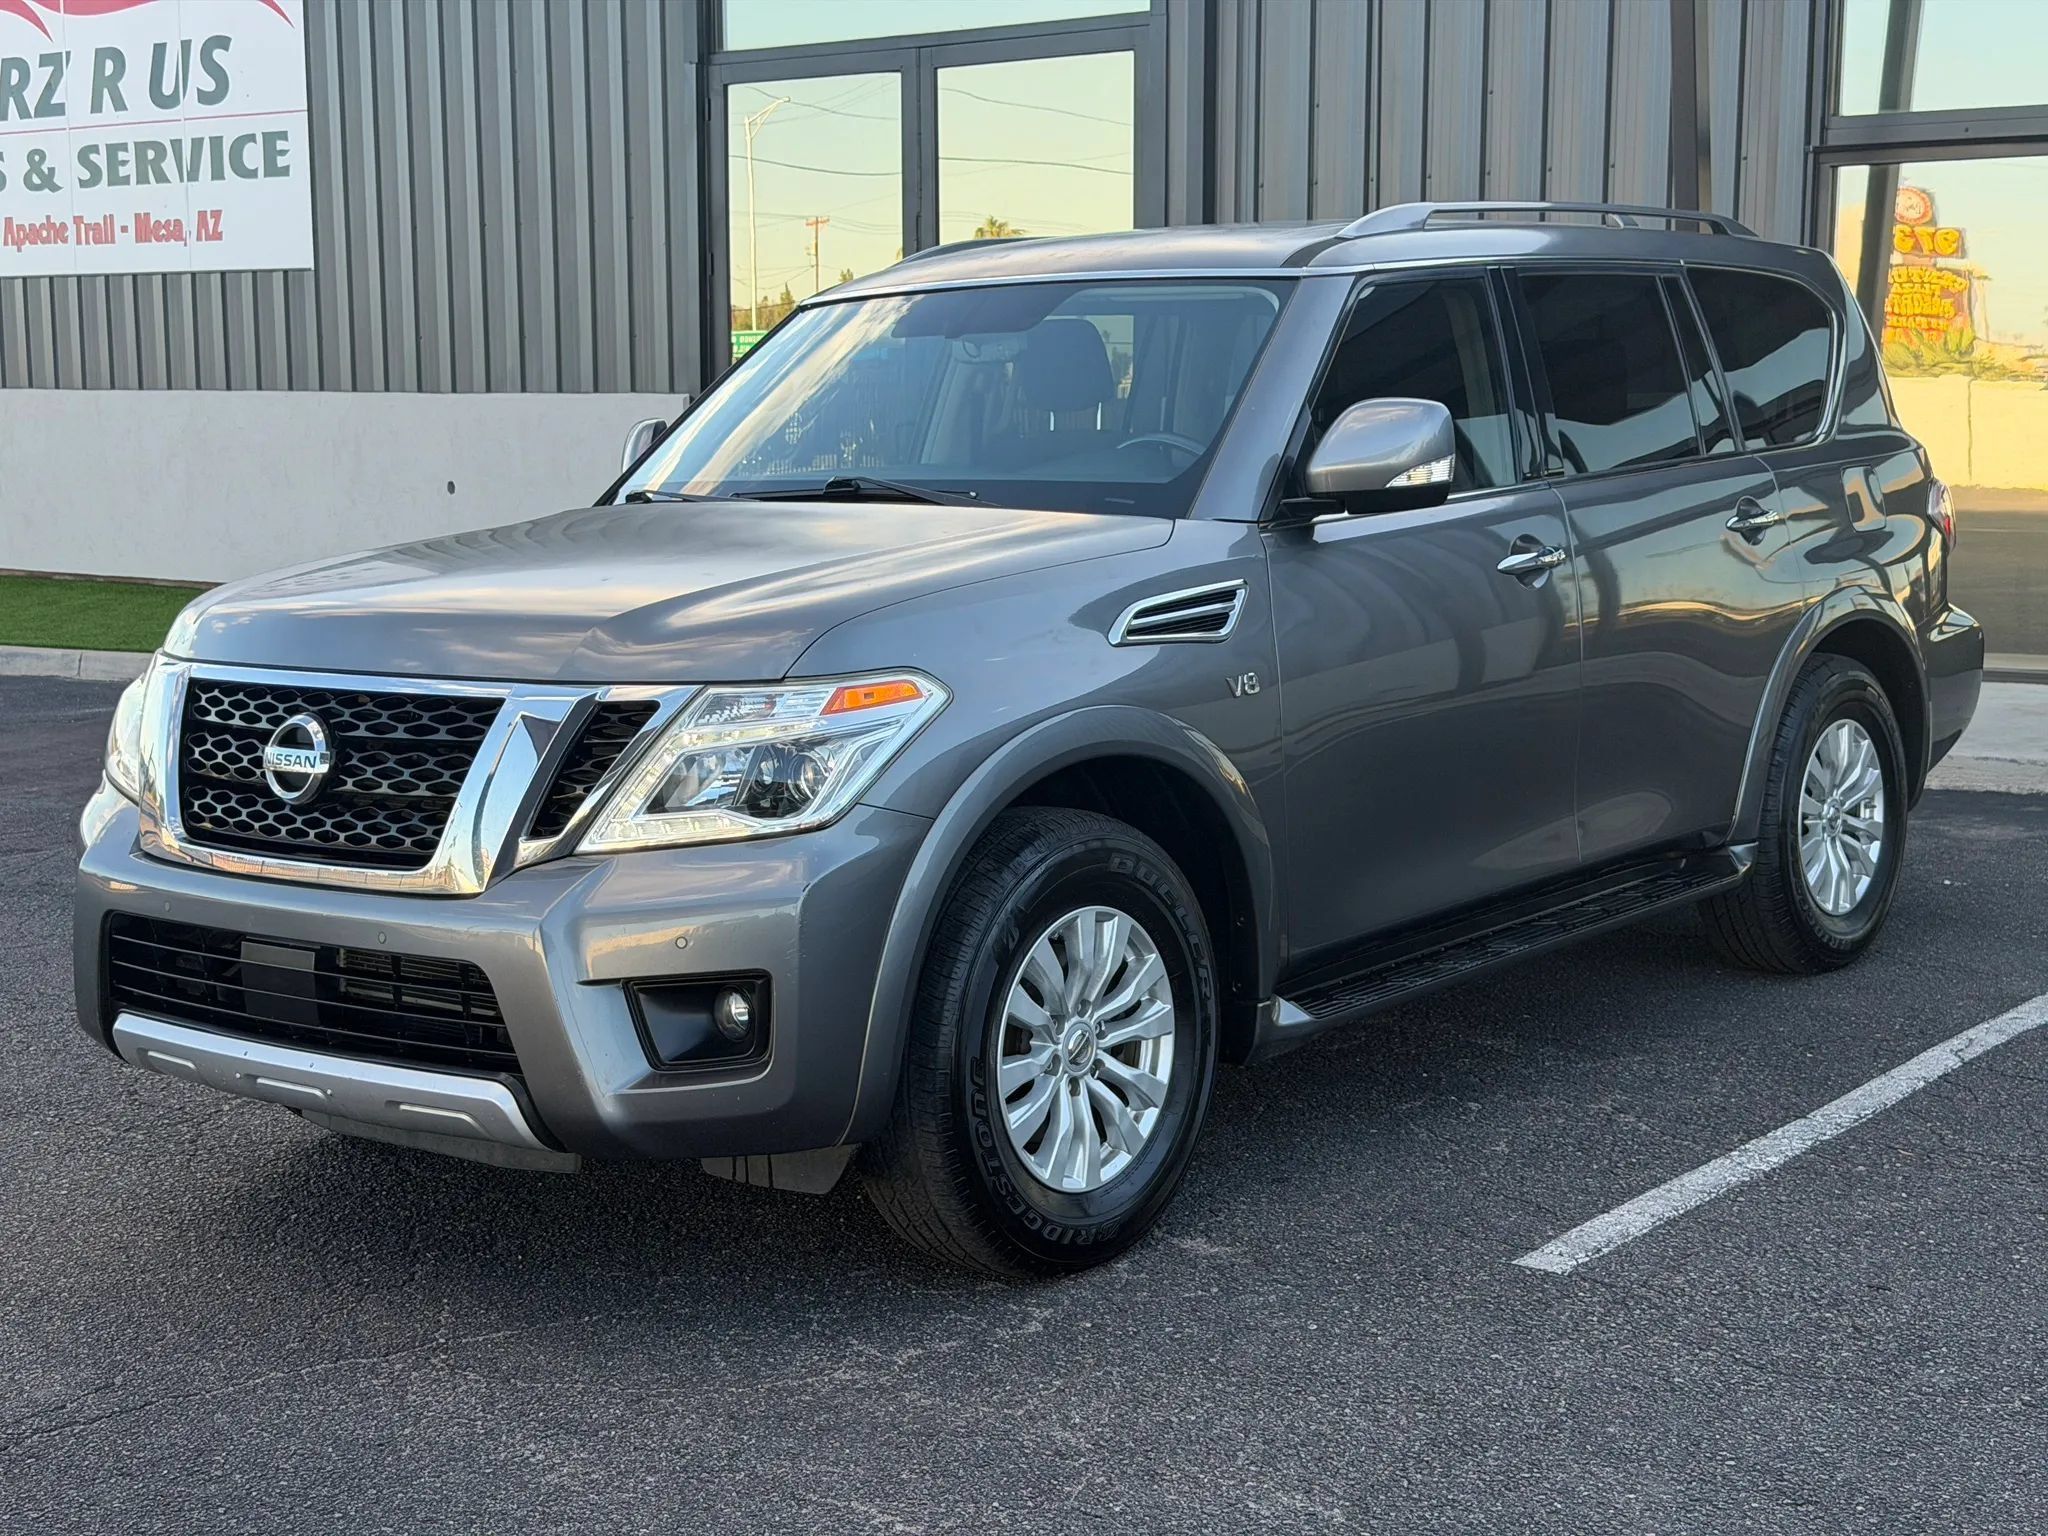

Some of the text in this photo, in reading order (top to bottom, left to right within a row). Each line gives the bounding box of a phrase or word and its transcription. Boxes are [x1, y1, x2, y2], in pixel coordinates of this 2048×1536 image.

[90, 46, 128, 114] R
[149, 34, 232, 110] US
[23, 148, 64, 193] &
[76, 130, 291, 189] SERVICE
[3, 214, 69, 252] Apache
[73, 213, 116, 246] Trail
[196, 209, 223, 242] AZ
[1225, 672, 1260, 698] V8
[264, 751, 317, 769] NISSAN
[1109, 850, 1212, 1003] DUELER
[969, 1055, 1121, 1246] BRIDGESTONE
